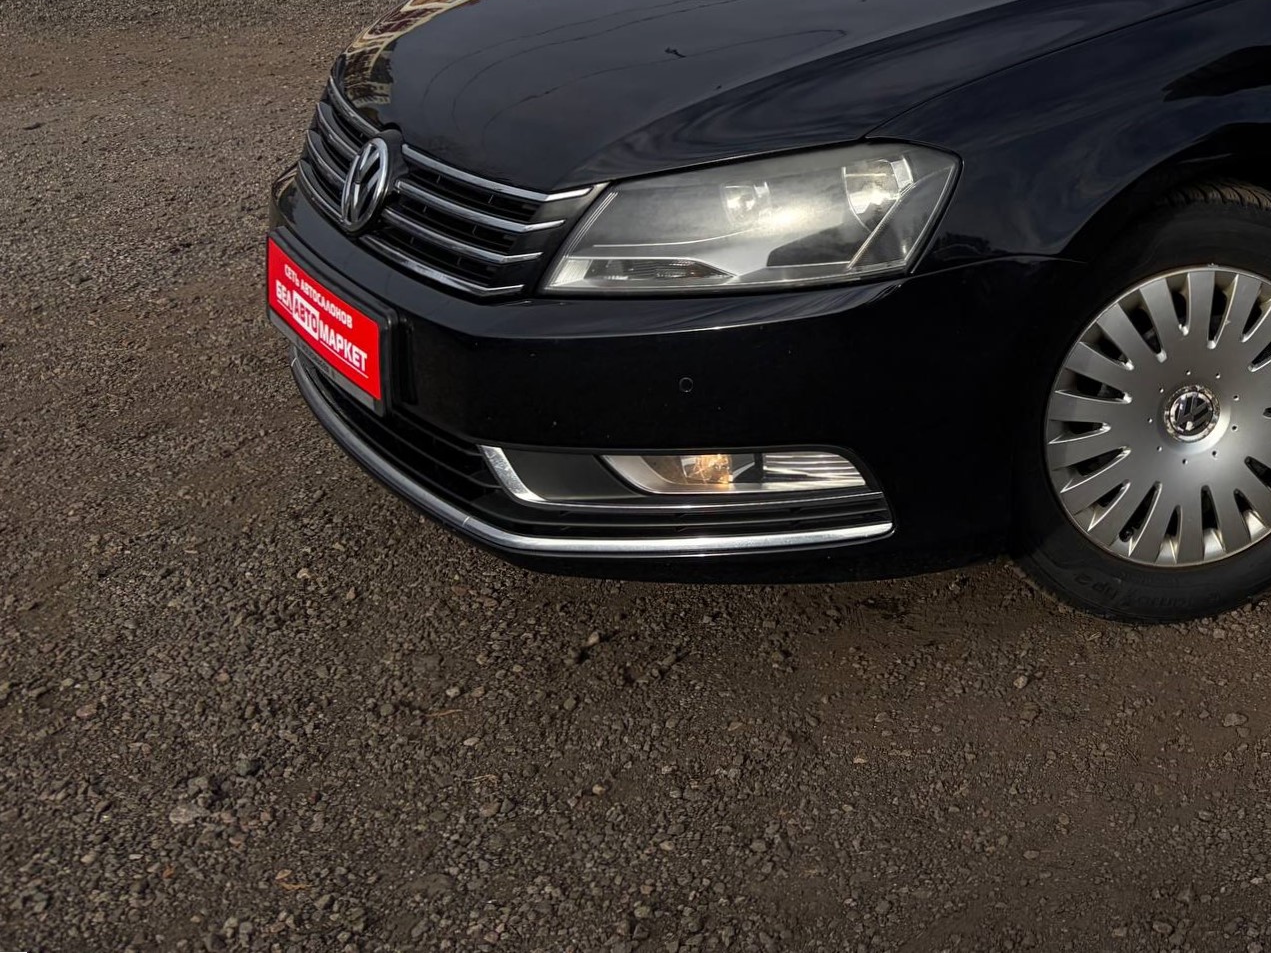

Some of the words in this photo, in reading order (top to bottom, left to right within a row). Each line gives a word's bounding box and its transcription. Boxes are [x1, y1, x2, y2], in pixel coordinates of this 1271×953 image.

[276, 279, 293, 312] БЕЛ
[293, 296, 318, 336] АВТО
[319, 320, 368, 372] МАРКЕТ
[284, 264, 299, 286] СЕТЬ
[300, 279, 353, 330] АВТОСАЛОНОВ
